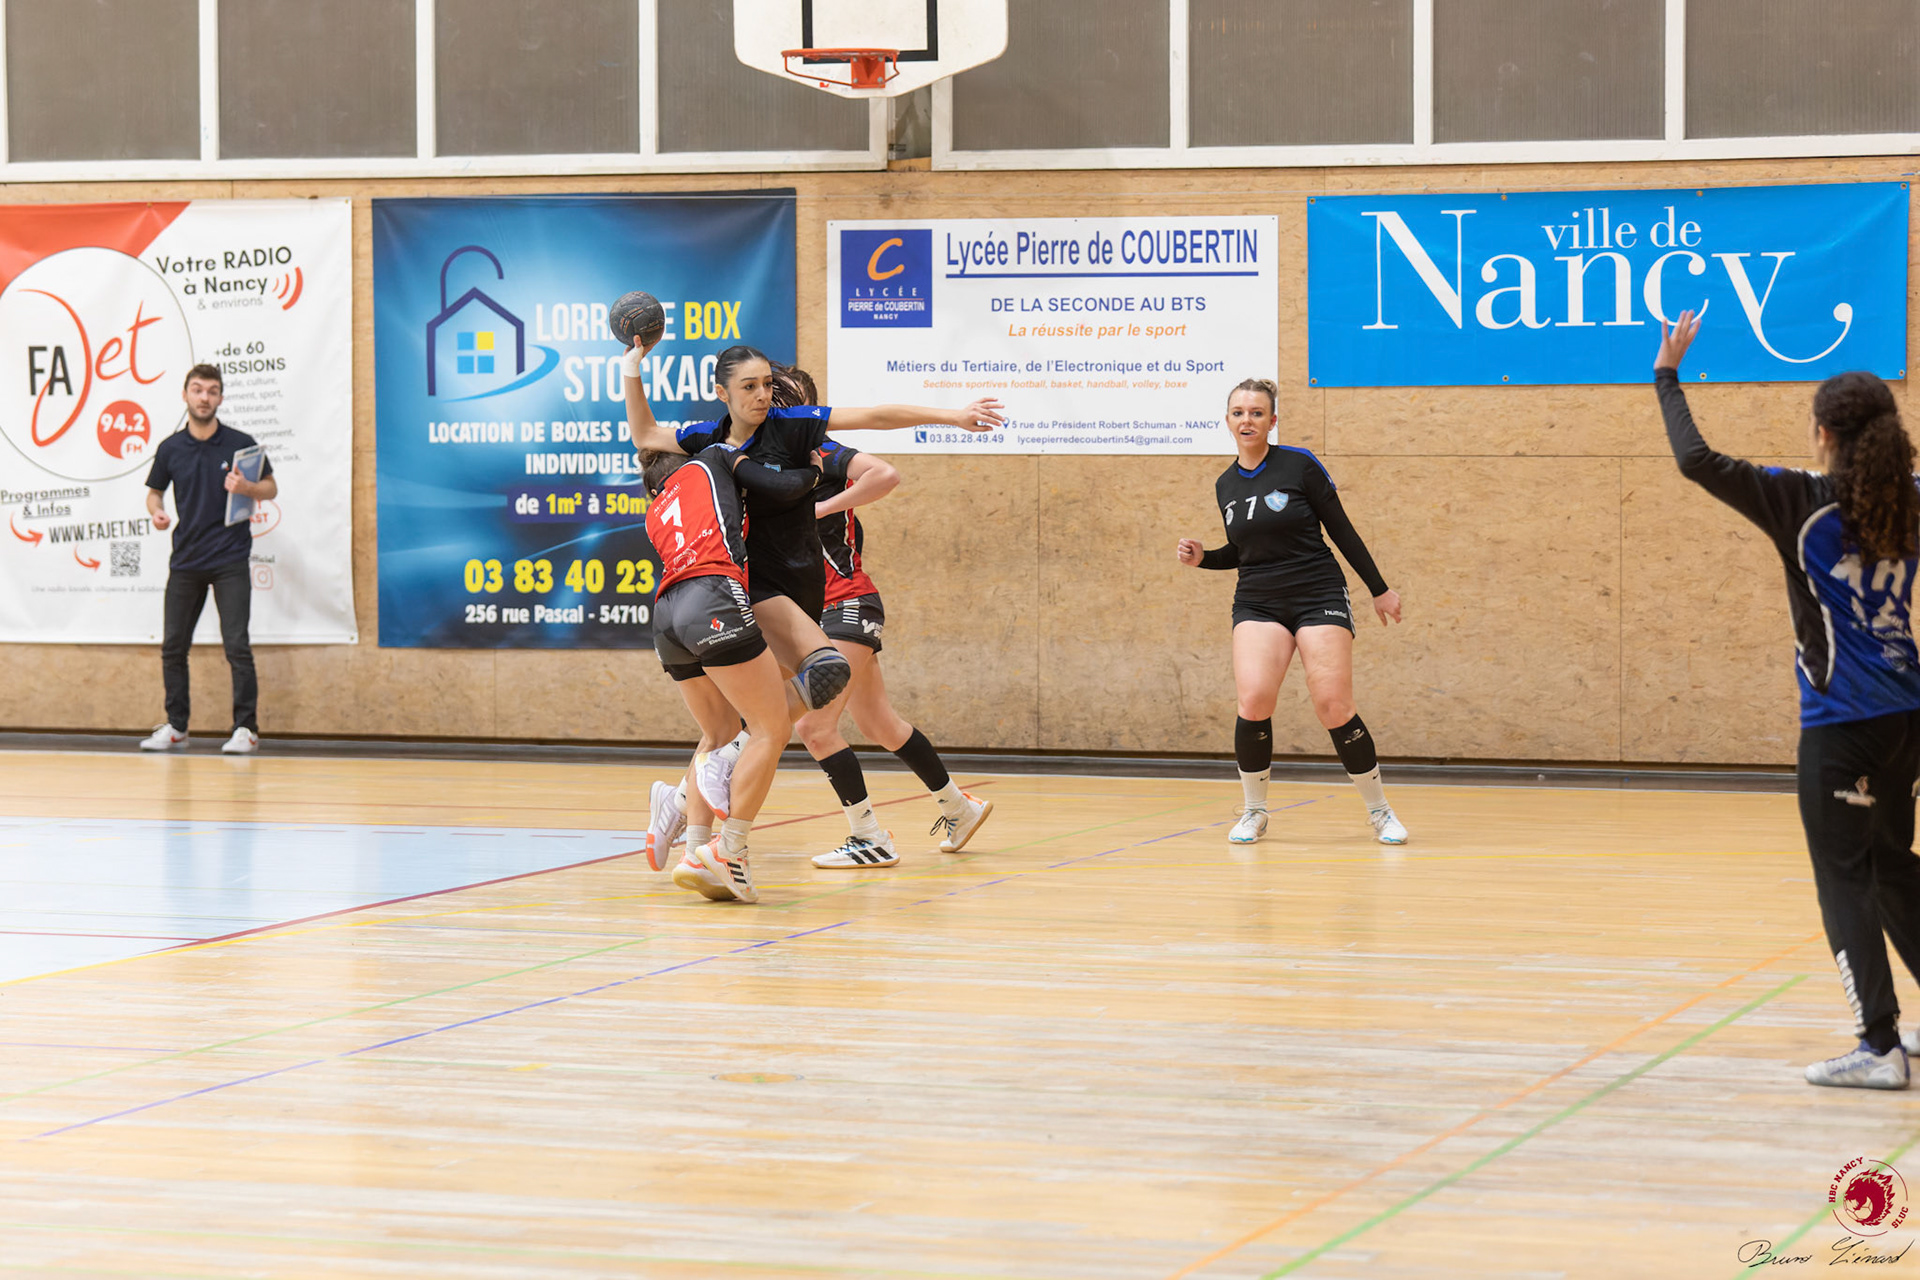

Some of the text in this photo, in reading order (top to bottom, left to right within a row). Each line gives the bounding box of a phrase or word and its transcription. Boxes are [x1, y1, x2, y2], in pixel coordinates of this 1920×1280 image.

[1541, 205, 1702, 251] ville de
[156, 246, 292, 274] Votre RADIO
[946, 229, 1258, 276] Lycée Pierre de COUBERTIN
[184, 276, 268, 295] à Nancy
[855, 286, 918, 297] LYCÉE
[1360, 208, 1854, 364] Nancy
[197, 296, 263, 310] & environs
[848, 301, 926, 312] PIERRE de COUBERTIN
[990, 296, 1206, 312] DE LA SECONDE AU BTS
[536, 300, 742, 342] LORRE BOX
[1008, 322, 1187, 340] La réussite par le sport
[246, 341, 265, 354] 60
[886, 360, 1225, 374] Métiers du Tertiaire, de l'Electronique et du Sport
[563, 354, 718, 402] STOKAG
[922, 380, 1188, 390] Sections sportives football, basket, handball, volley, boxe
[101, 412, 145, 433] 94.2
[428, 420, 633, 444] LOCATION DE BOXES D
[1012, 420, 1018, 429] 5
[1037, 420, 1049, 429] du
[1052, 420, 1096, 430] Président
[1098, 420, 1131, 429] Robert
[1132, 420, 1177, 429] Schuman
[1185, 420, 1221, 429] NANCY
[126, 442, 142, 454] FM
[930, 434, 1004, 444] 03.83.28.49.49
[1017, 434, 1193, 446] lyceepierredecoubertin54@gmail.com
[525, 452, 642, 475] INDIVIDUELS
[0, 486, 90, 503] Programmes
[514, 493, 540, 516] de
[546, 492, 582, 514] 1m²
[588, 492, 600, 514] à
[23, 502, 72, 516] & Infos
[49, 518, 152, 544] WWW.FAJET.NET
[660, 496, 685, 552] 7
[464, 558, 504, 594] 03
[514, 558, 554, 594] 83
[565, 559, 605, 594] 40
[616, 559, 655, 594] 23
[464, 604, 498, 624] 256
[502, 606, 530, 624] rue
[534, 604, 584, 624] Pascal
[599, 604, 650, 624] 54710
